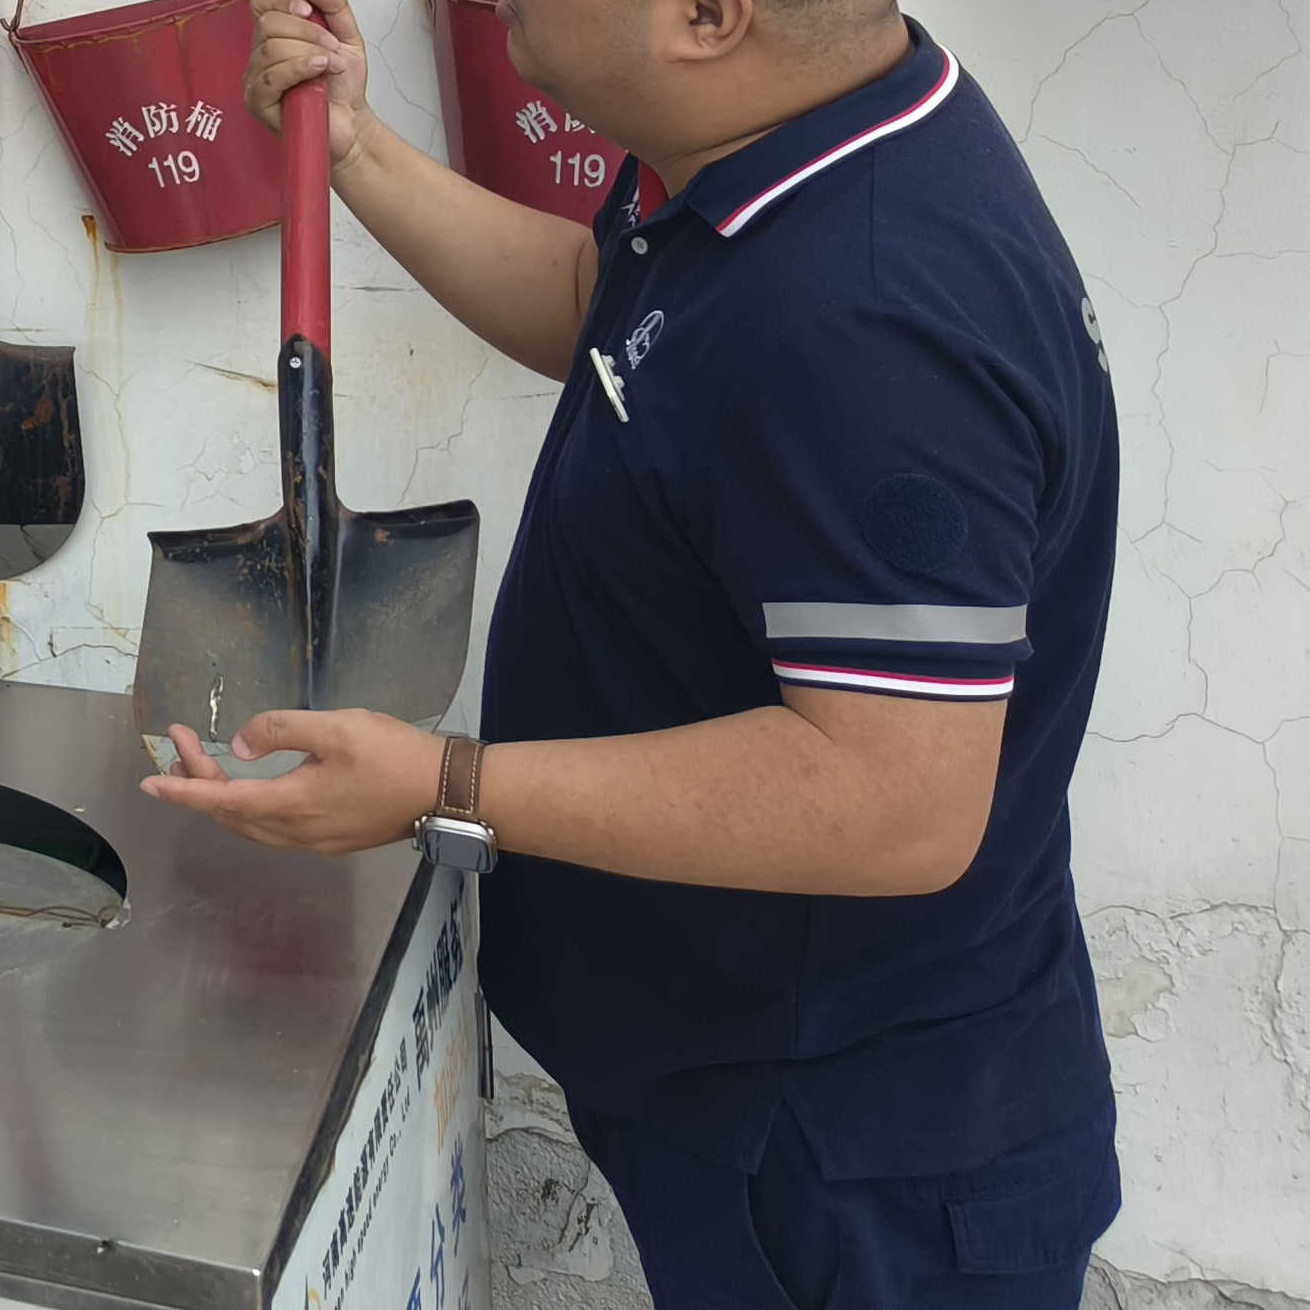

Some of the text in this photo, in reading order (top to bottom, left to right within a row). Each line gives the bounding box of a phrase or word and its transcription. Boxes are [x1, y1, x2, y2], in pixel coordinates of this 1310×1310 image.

[104, 99, 224, 158] 消防桶
[146, 149, 201, 189] 119
[549, 149, 607, 188] 119
